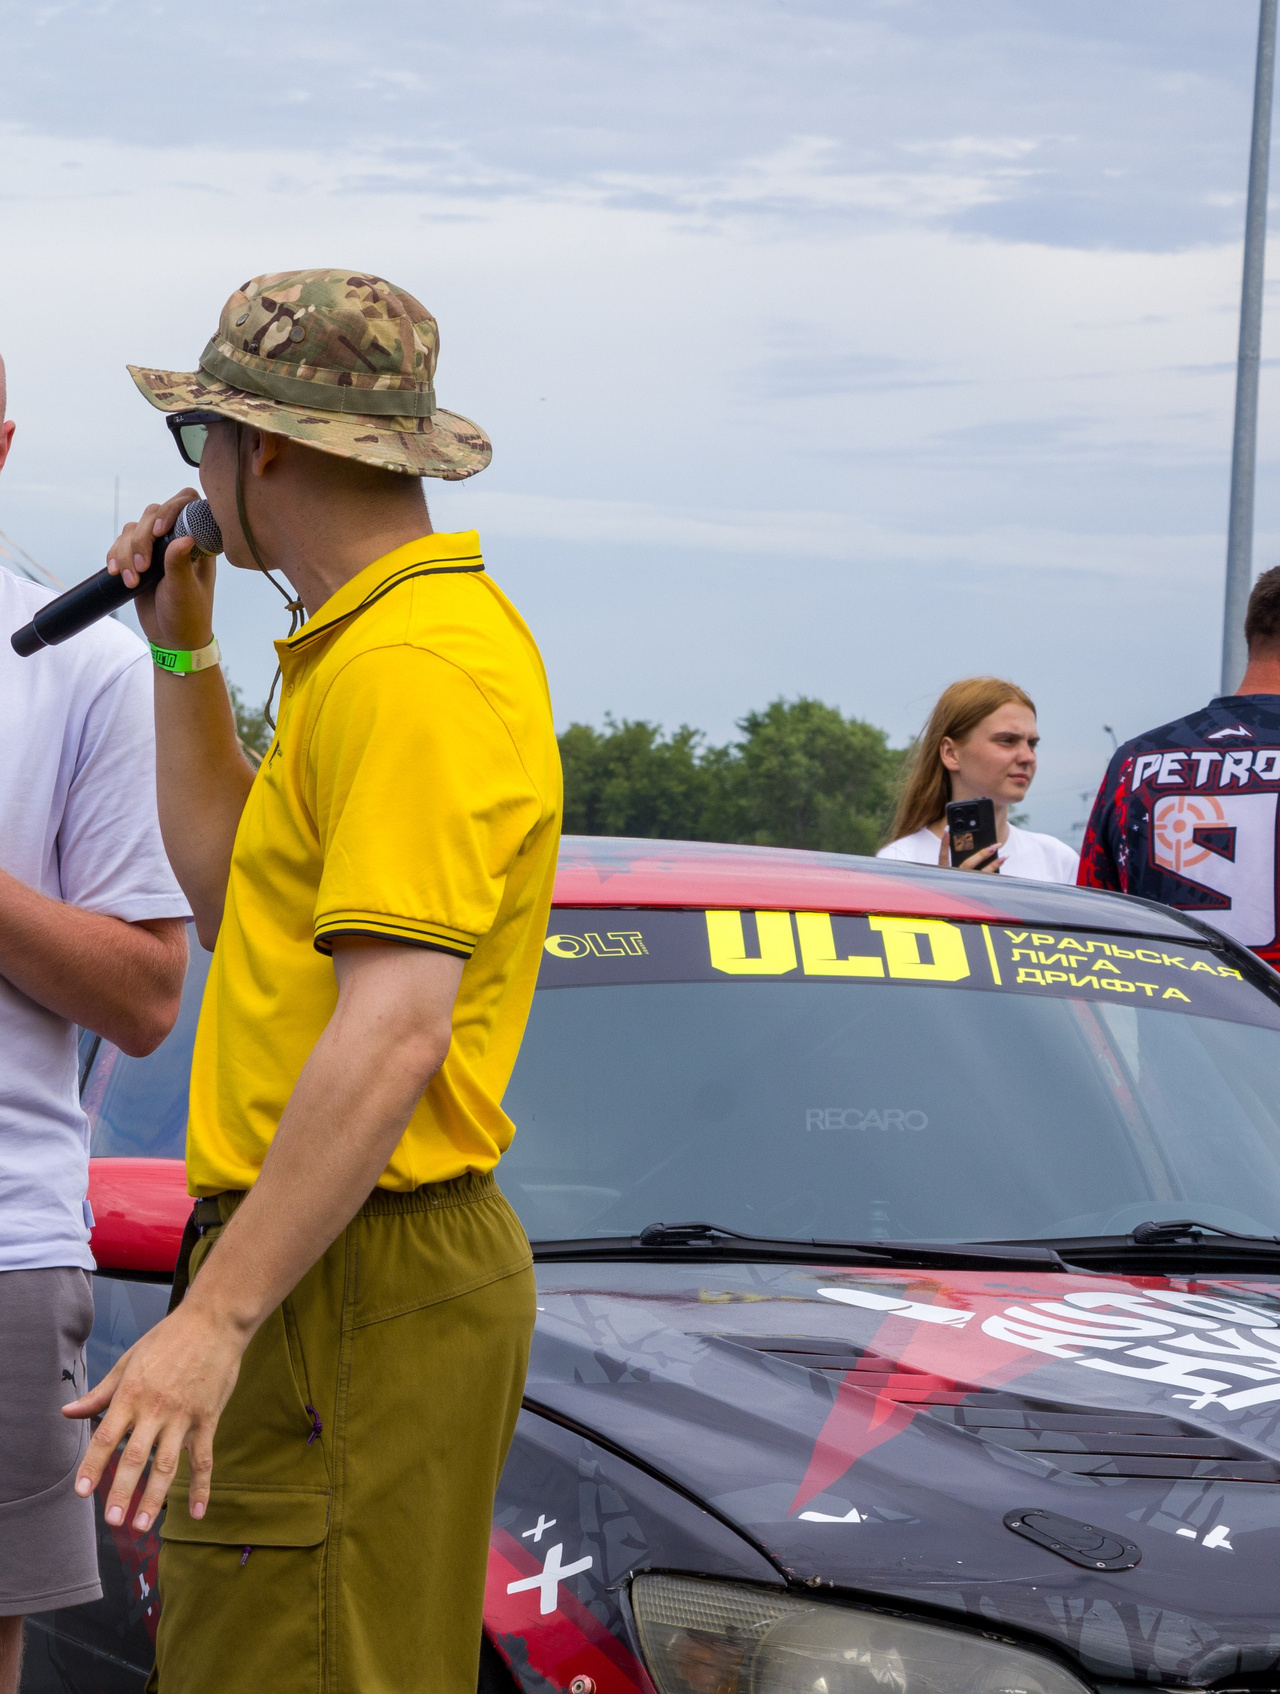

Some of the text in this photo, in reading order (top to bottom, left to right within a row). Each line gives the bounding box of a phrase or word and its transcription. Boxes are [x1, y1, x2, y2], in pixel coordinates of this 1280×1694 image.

[1154, 792, 1280, 947] 9
[705, 910, 971, 982] ULD
[1003, 930, 1244, 981] УРАЛЬСКАЯ
[1011, 948, 1122, 974] ЛИГА
[1016, 967, 1192, 1003] ДРИФТА
[805, 1108, 929, 1132] RECARO
